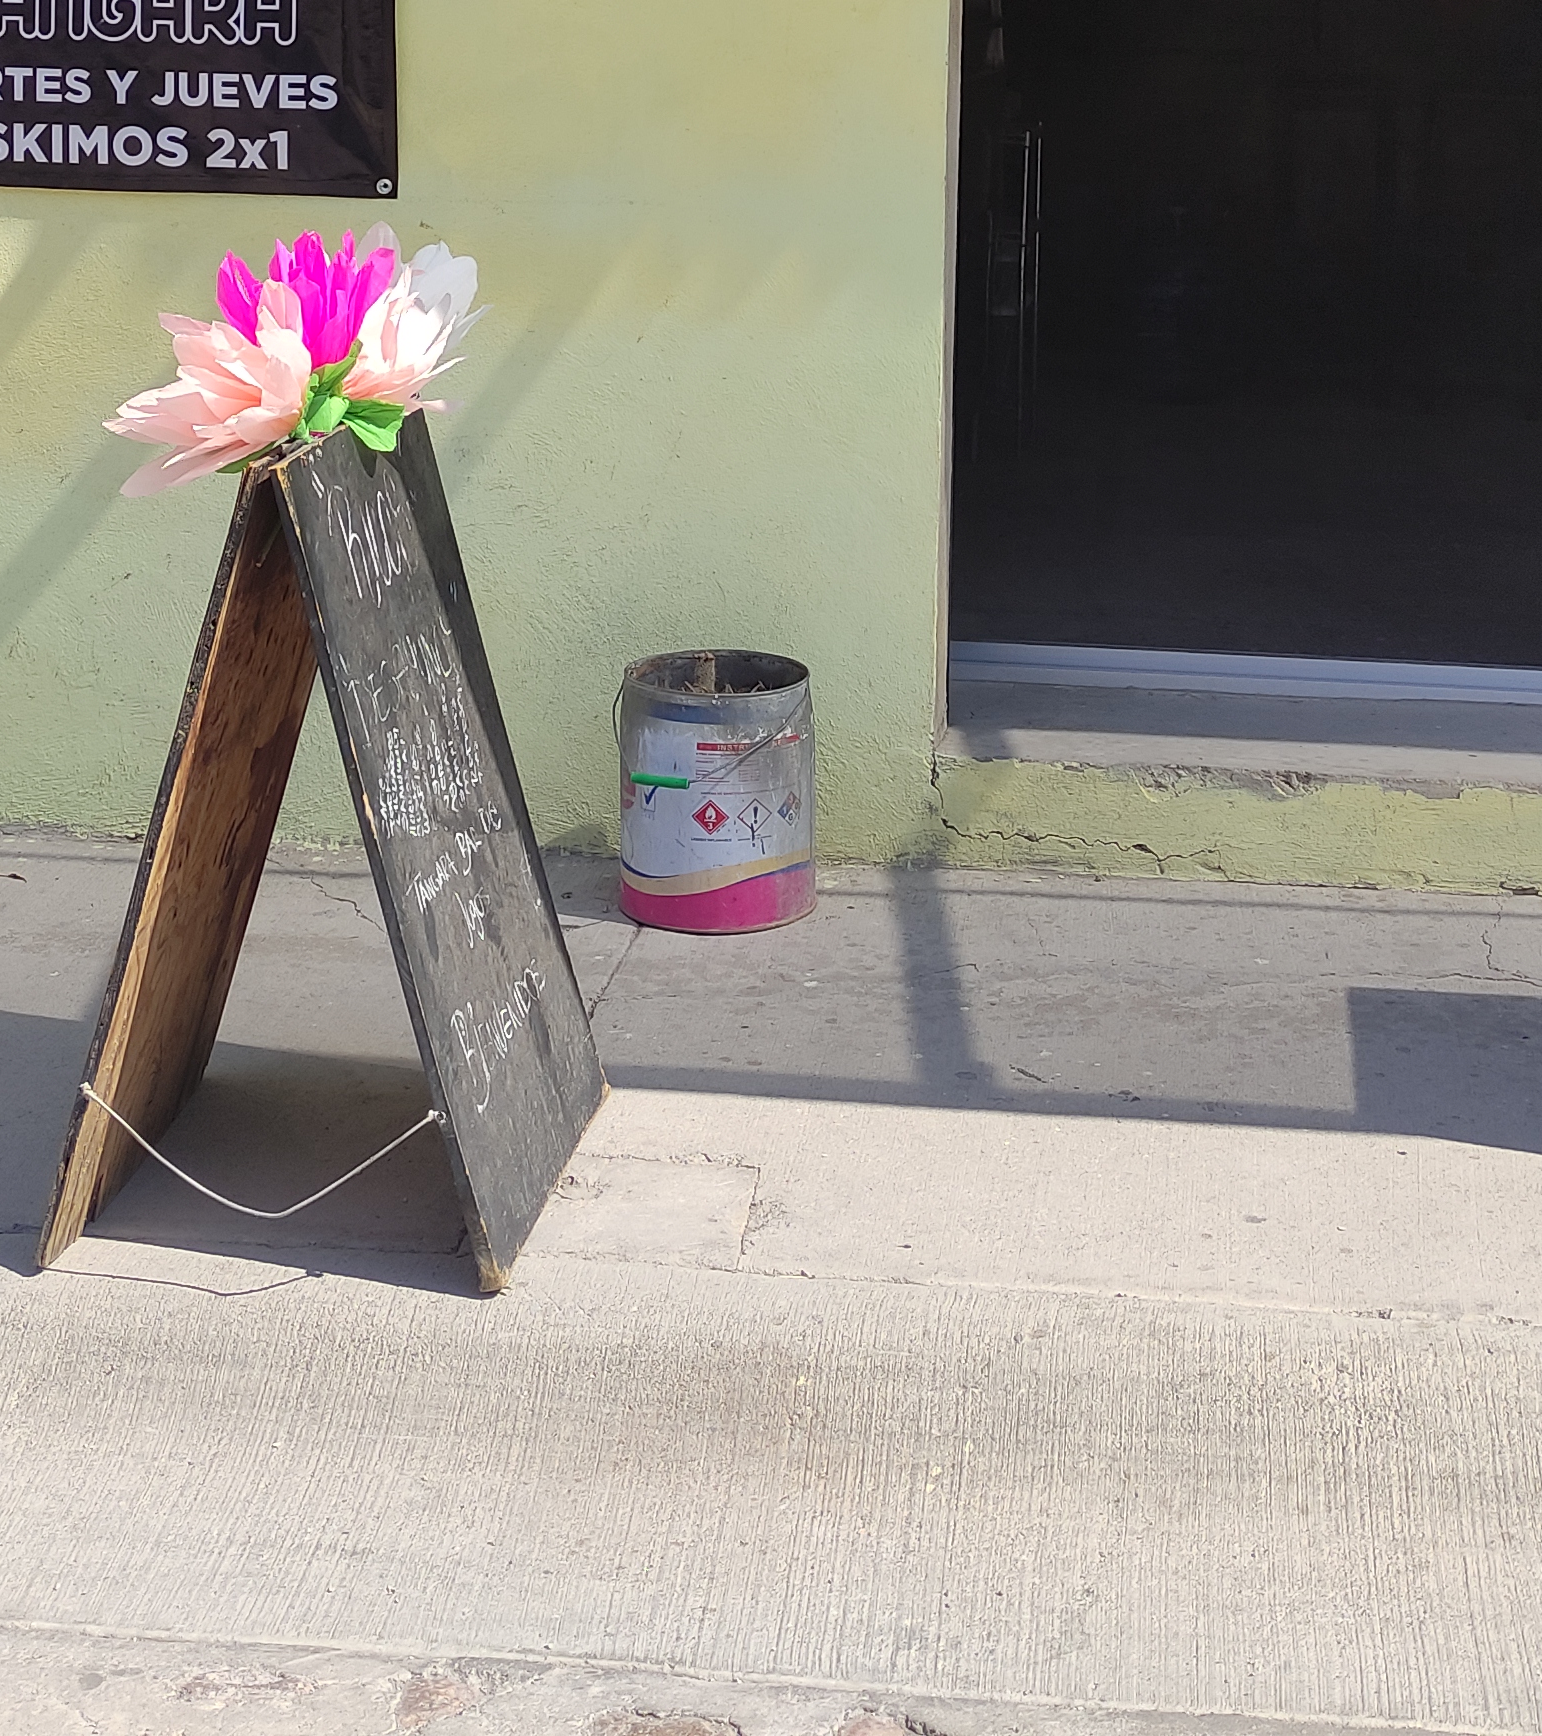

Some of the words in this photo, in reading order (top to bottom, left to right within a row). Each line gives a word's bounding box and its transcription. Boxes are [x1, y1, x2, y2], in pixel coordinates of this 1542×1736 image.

[106, 70, 138, 104] Y
[152, 72, 338, 110] JUEVES
[206, 130, 290, 171] 2x1
